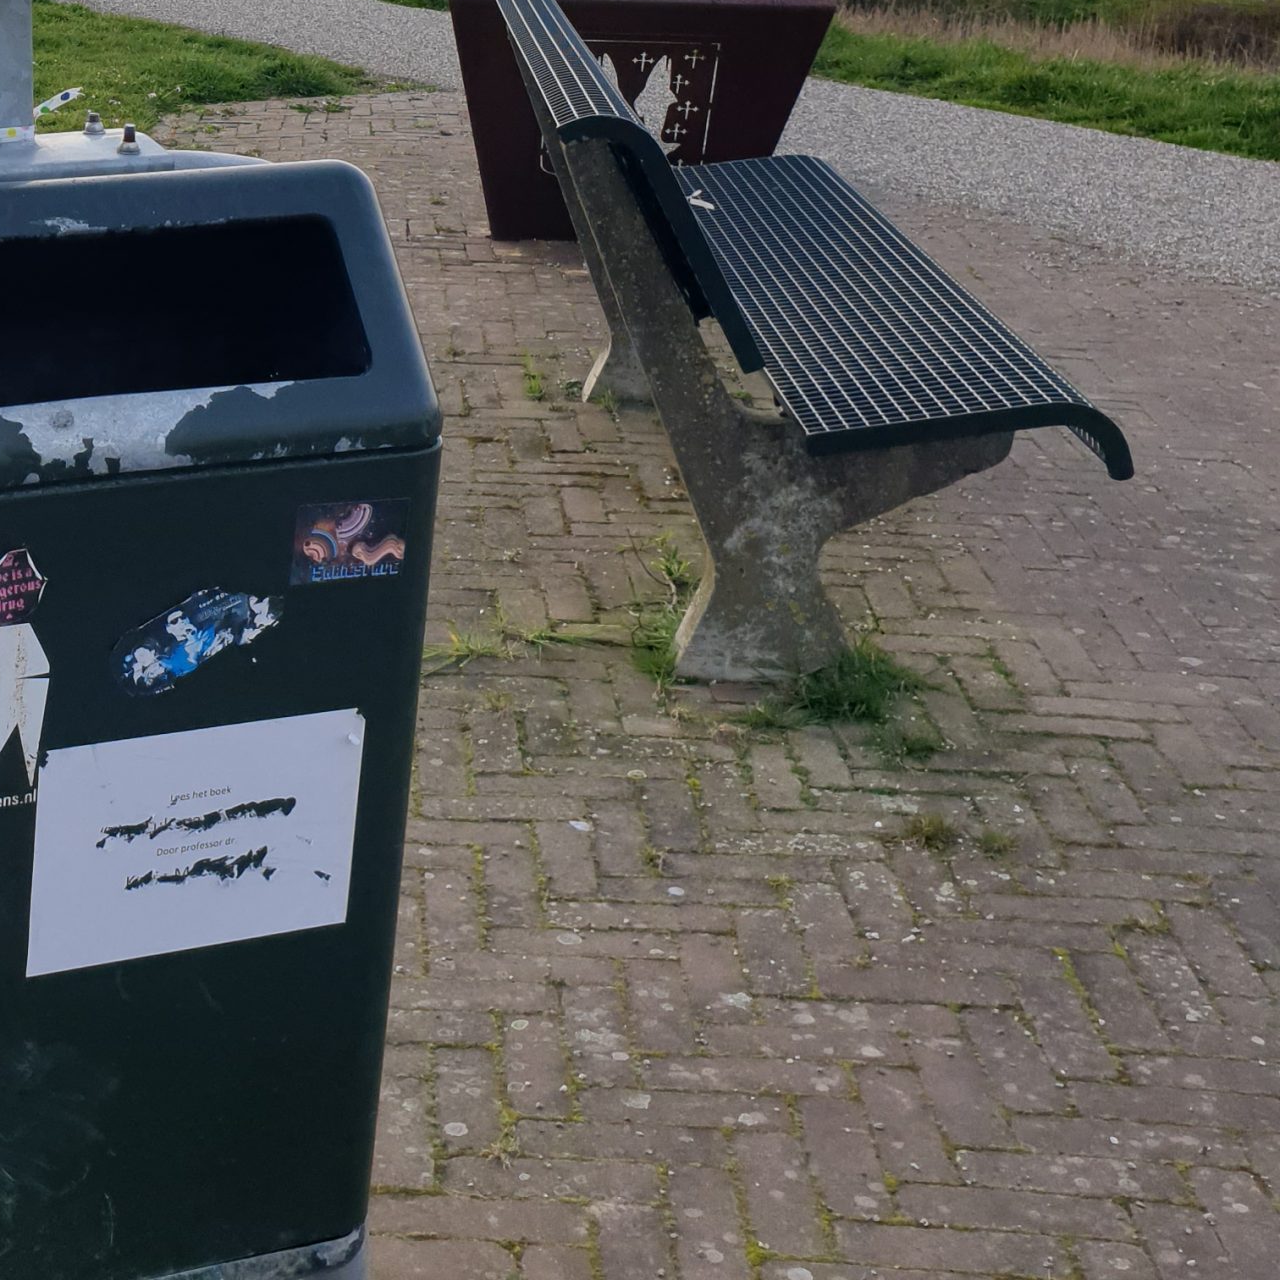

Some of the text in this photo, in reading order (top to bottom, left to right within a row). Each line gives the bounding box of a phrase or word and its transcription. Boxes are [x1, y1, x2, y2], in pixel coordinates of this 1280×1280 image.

[12, 568, 23, 581] is
[25, 568, 32, 577] a
[192, 789, 207, 799] het
[209, 785, 232, 797] boek
[156, 845, 180, 857] Door
[180, 840, 222, 854] professor
